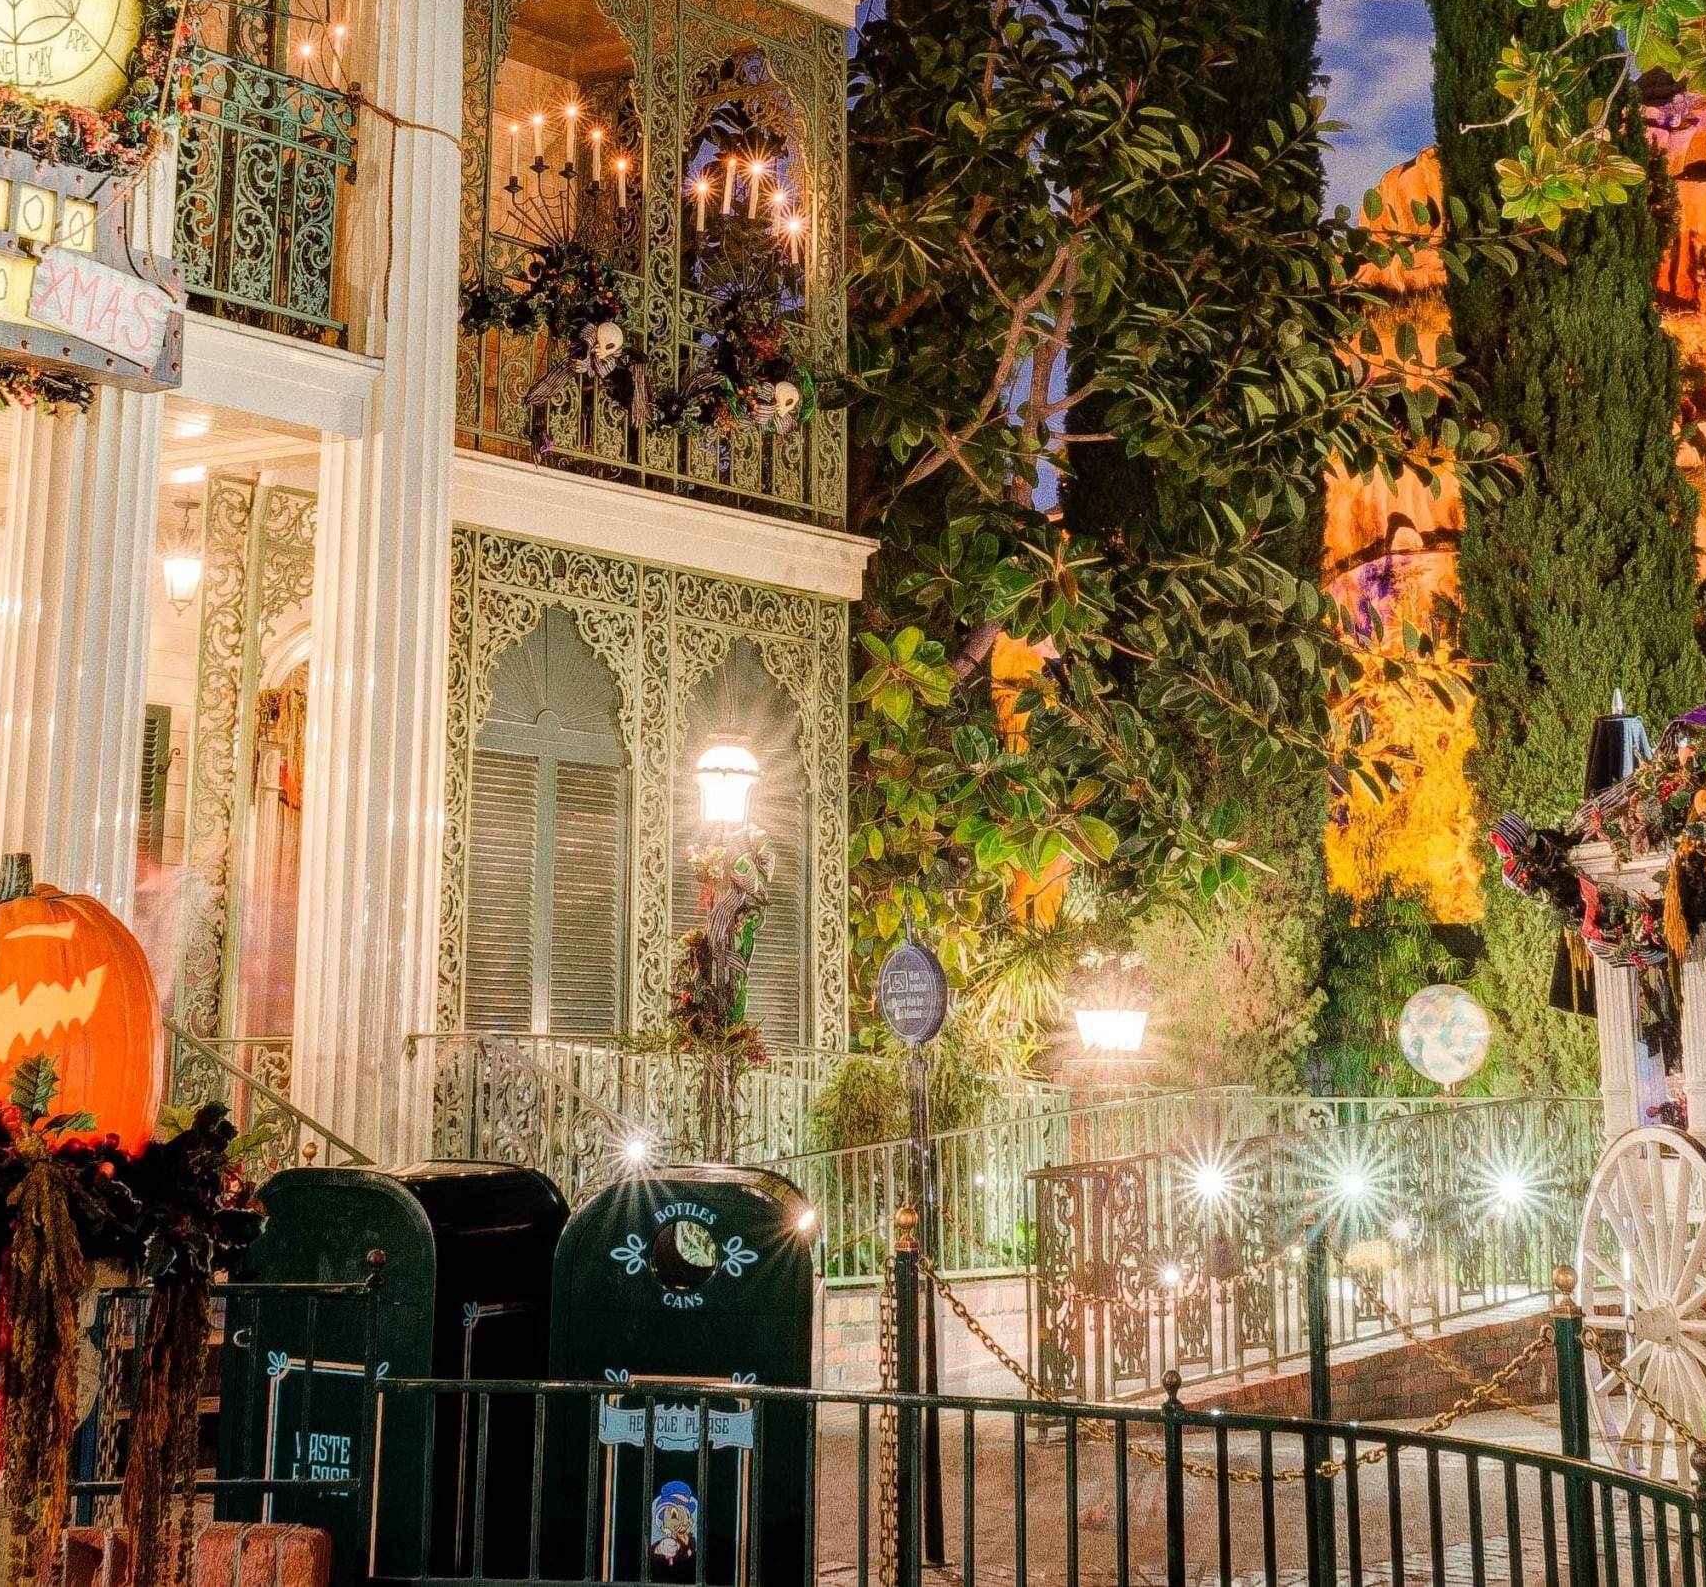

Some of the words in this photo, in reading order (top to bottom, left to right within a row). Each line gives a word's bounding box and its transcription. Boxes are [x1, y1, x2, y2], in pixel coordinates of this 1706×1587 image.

[65, 28, 92, 51] APR
[27, 46, 53, 78] MAY
[34, 258, 160, 352] XMAS
[654, 1202, 717, 1225] BOTTLES
[663, 1293, 704, 1309] CANS
[629, 1415, 678, 1434] RECLE
[685, 1416, 730, 1434] PLASE
